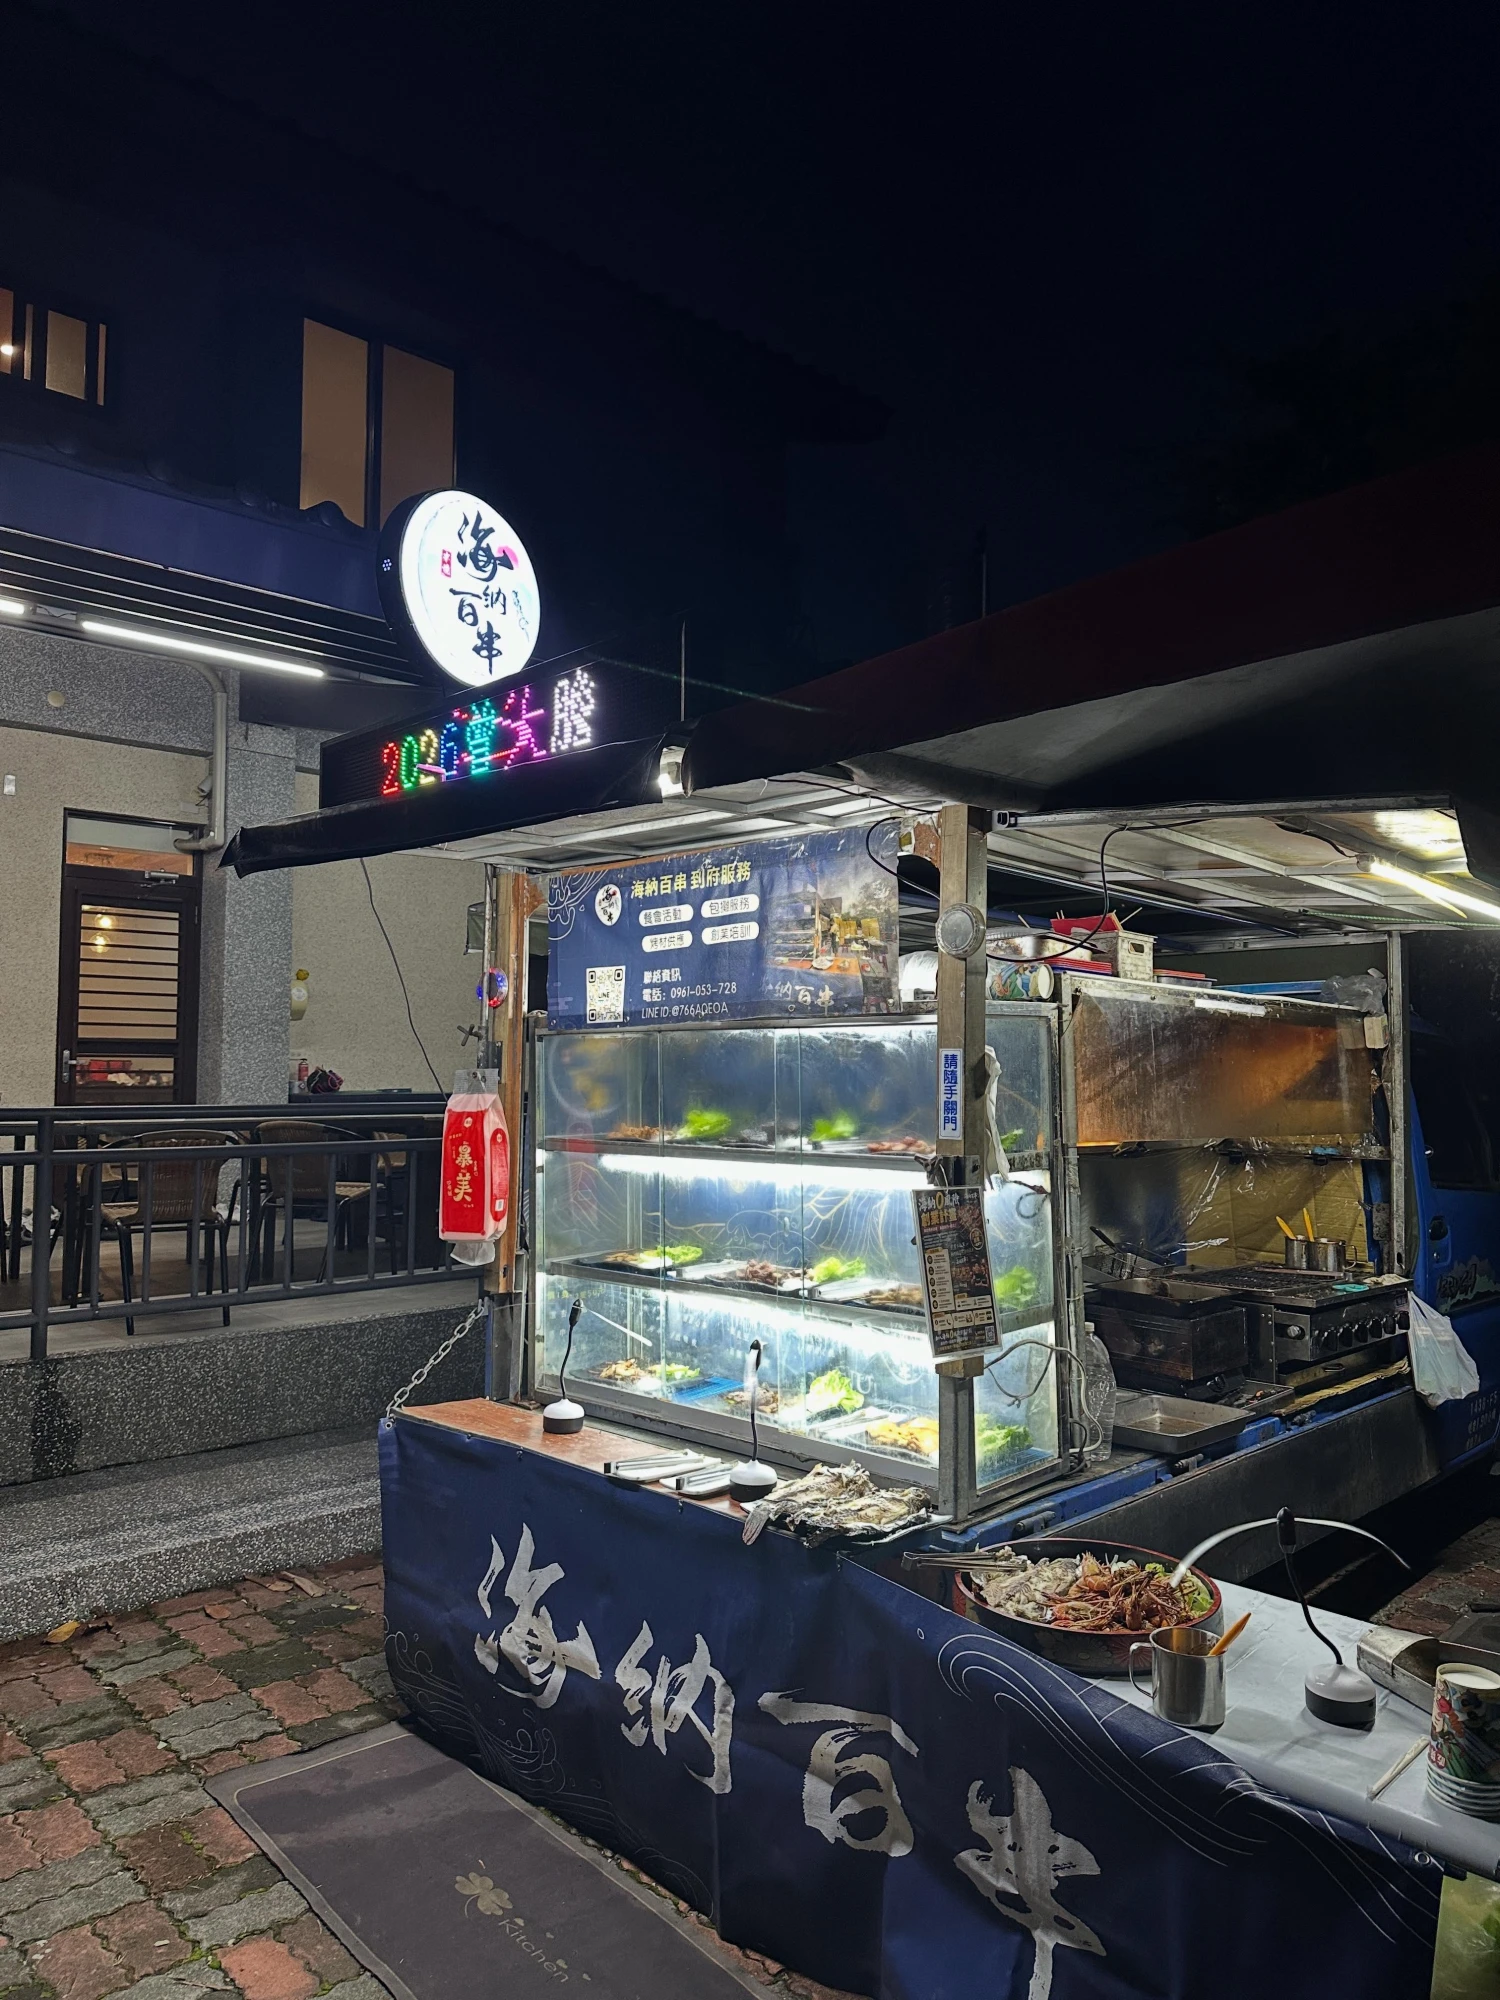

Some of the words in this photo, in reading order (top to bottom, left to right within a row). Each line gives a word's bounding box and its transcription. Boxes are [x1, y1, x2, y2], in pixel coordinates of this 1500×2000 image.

[711, 924, 751, 941] 創業培訓
[643, 968, 681, 984] 聯絡資訊
[943, 1053, 958, 1132] 請隨手關門
[498, 1919, 569, 1983] Kitchen
